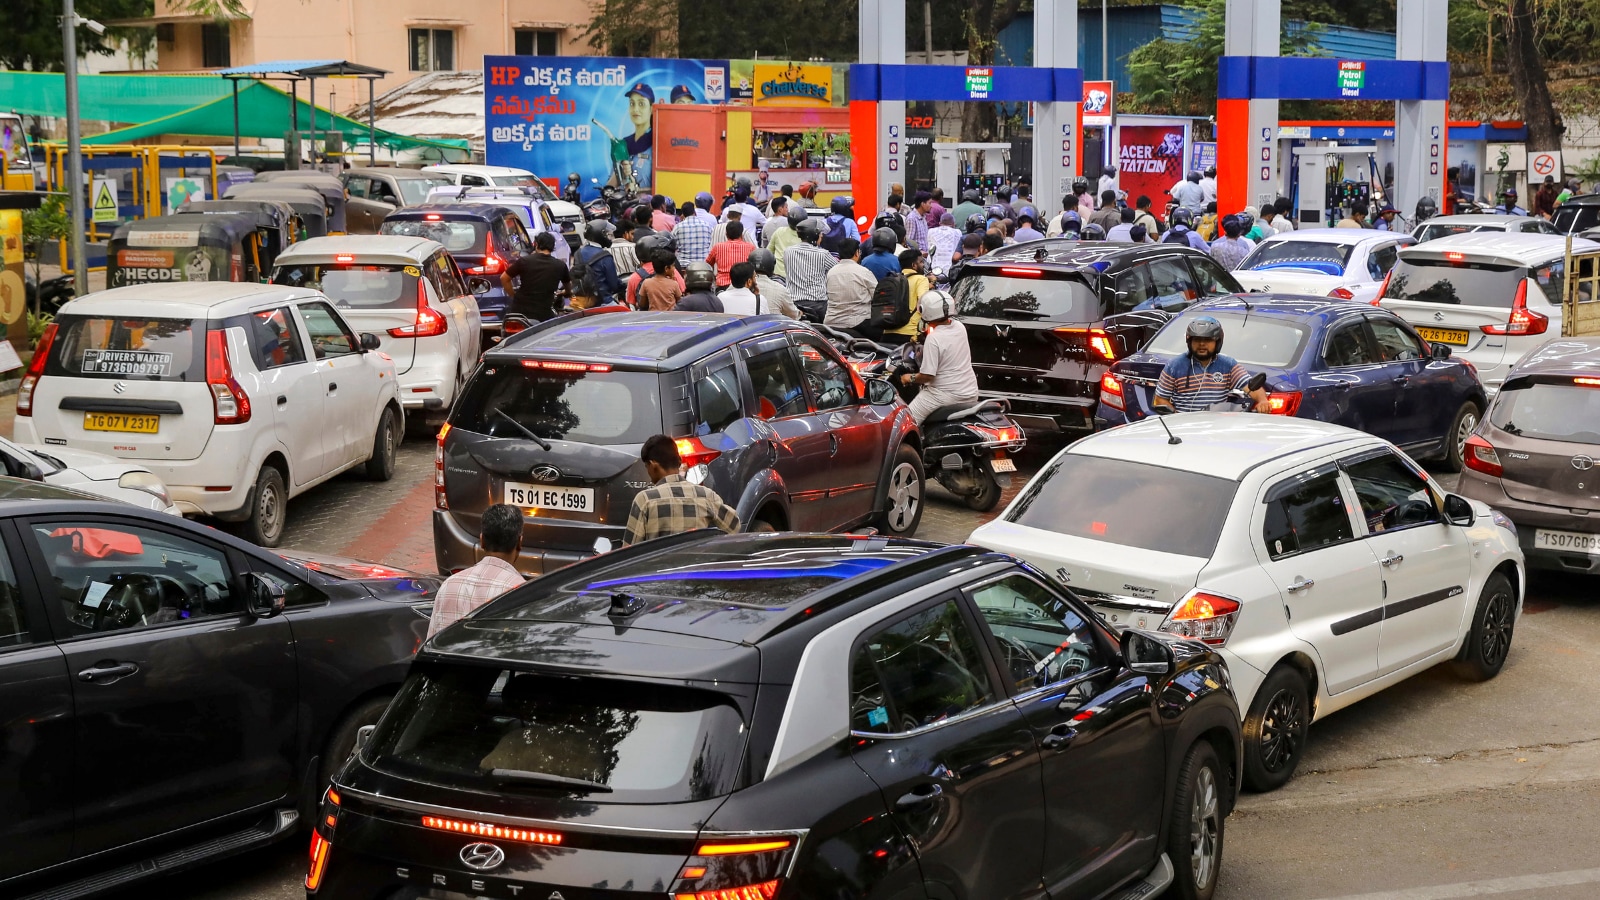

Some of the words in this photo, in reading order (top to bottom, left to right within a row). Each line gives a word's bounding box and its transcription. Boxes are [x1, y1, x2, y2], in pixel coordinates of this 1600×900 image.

[490, 66, 520, 85] HP
[524, 66, 572, 94] ఎక్కడ
[575, 65, 626, 86] ఉందో
[1339, 70, 1361, 79] Petrol
[1343, 79, 1359, 87] Petrol
[970, 90, 988, 98] Diesel
[1342, 88, 1359, 96] Diesel
[905, 116, 933, 129] PRO
[492, 123, 544, 151] అక్కడ
[548, 123, 592, 141] ఉంది
[126, 268, 181, 280] HEGDE
[1430, 331, 1440, 340] 26
[1441, 332, 1447, 340] T
[1447, 332, 1467, 342] 3781
[99, 352, 135, 362] DRIVERS
[136, 353, 170, 363] WANTED
[101, 362, 166, 374] 9736009797
[92, 415, 104, 427] TG
[107, 416, 120, 427] 07
[122, 417, 129, 428] V
[131, 418, 158, 430] 2317
[1508, 452, 1530, 460] TIAGO
[510, 488, 525, 504] TS
[527, 490, 539, 505] 01
[543, 491, 558, 506] EC
[560, 494, 587, 509] 1599
[1122, 584, 1159, 594] SWIFT
[396, 867, 566, 900] CRETA
